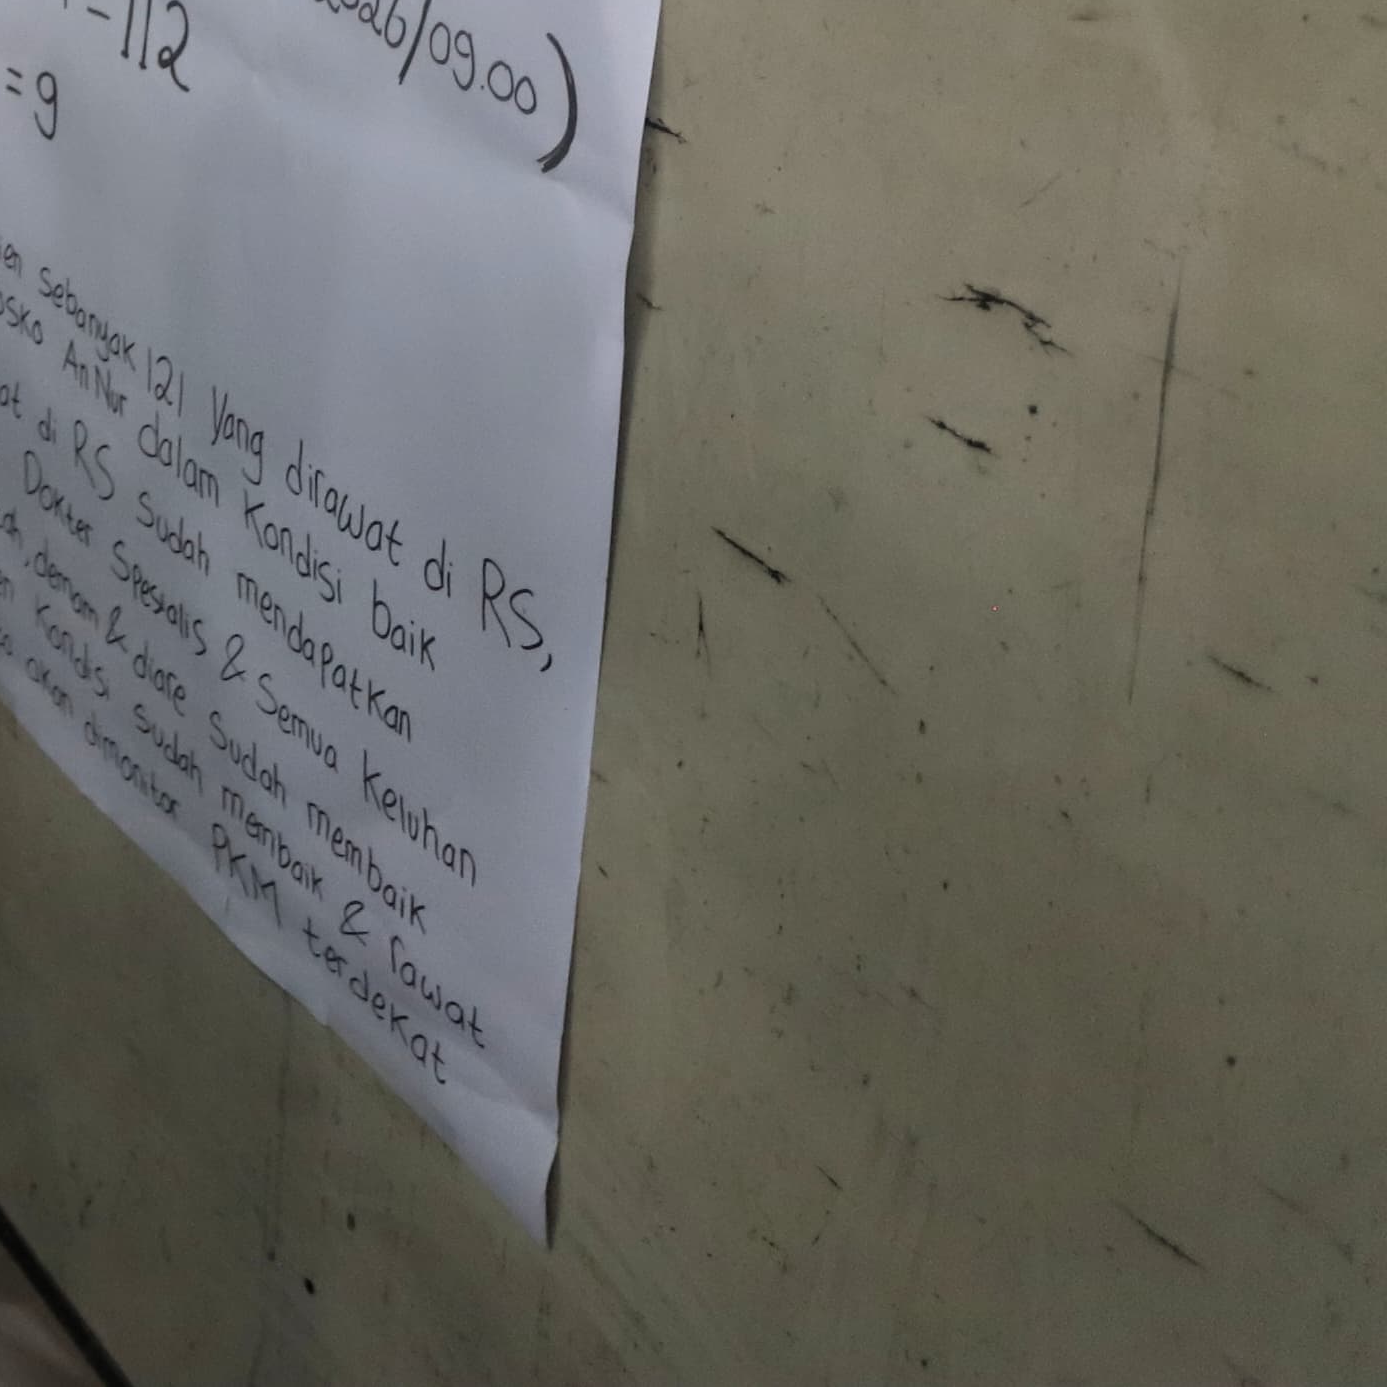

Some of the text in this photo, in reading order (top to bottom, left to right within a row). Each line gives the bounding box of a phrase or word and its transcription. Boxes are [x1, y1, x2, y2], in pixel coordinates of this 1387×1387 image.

[38, 407, 56, 444] di
[74, 420, 114, 500] RS
[137, 491, 210, 576] Sudah
[237, 571, 411, 744] mendapatkan
[39, 267, 135, 371] Sebanyak
[147, 347, 185, 417] 121
[211, 385, 265, 485] Yang
[286, 439, 404, 566] dirawat
[424, 539, 453, 598] di
[138, 411, 219, 508] dalam
[245, 489, 342, 604] Kondisi
[373, 579, 435, 671] baik
[24, 450, 93, 547] Dokter
[220, 633, 247, 681] &
[256, 673, 338, 772] Semua
[363, 750, 477, 887] Keluhan
[105, 605, 128, 654] &
[133, 641, 187, 717] diare
[209, 710, 287, 810] Sudah
[306, 801, 426, 934] membaik
[133, 703, 204, 794] Sudah
[221, 783, 324, 902] membaik
[340, 900, 370, 946] &
[390, 935, 485, 1049] rawat
[211, 822, 281, 929] PKM
[303, 916, 447, 1085] terdekat
